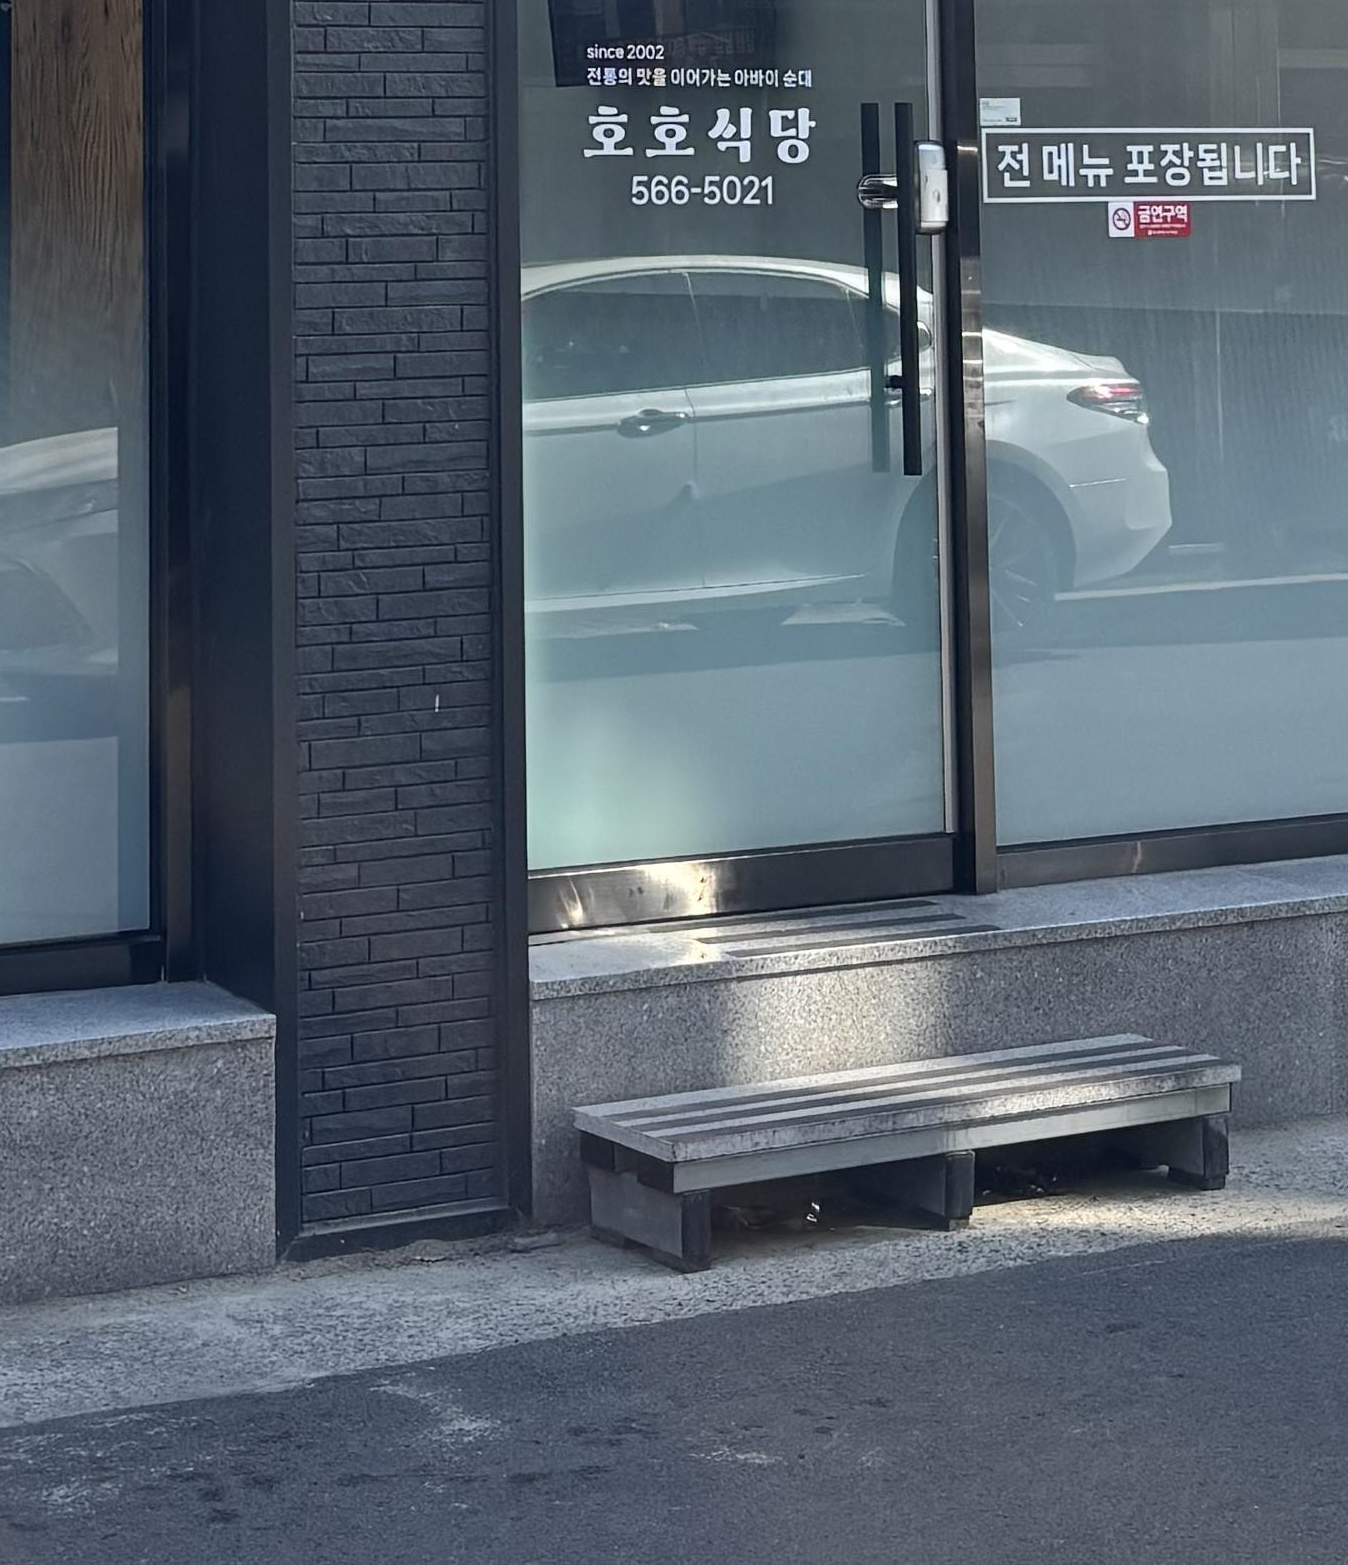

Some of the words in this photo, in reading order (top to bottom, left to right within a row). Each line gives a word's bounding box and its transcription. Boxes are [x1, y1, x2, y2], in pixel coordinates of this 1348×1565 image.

[586, 44, 624, 60] since
[627, 44, 665, 60] 2002
[586, 67, 632, 87] 전통의
[636, 67, 667, 87] 맛을
[670, 68, 732, 88] 이어가는
[734, 69, 779, 88] 아바이
[782, 69, 812, 88] 순대
[583, 105, 817, 164] 호호식당
[997, 141, 1031, 188] 전
[1042, 141, 1114, 188] 메뉴
[1124, 141, 1302, 188] 포장됩니다
[630, 175, 774, 205] 566-5021
[1137, 204, 1188, 224] 금연구역
